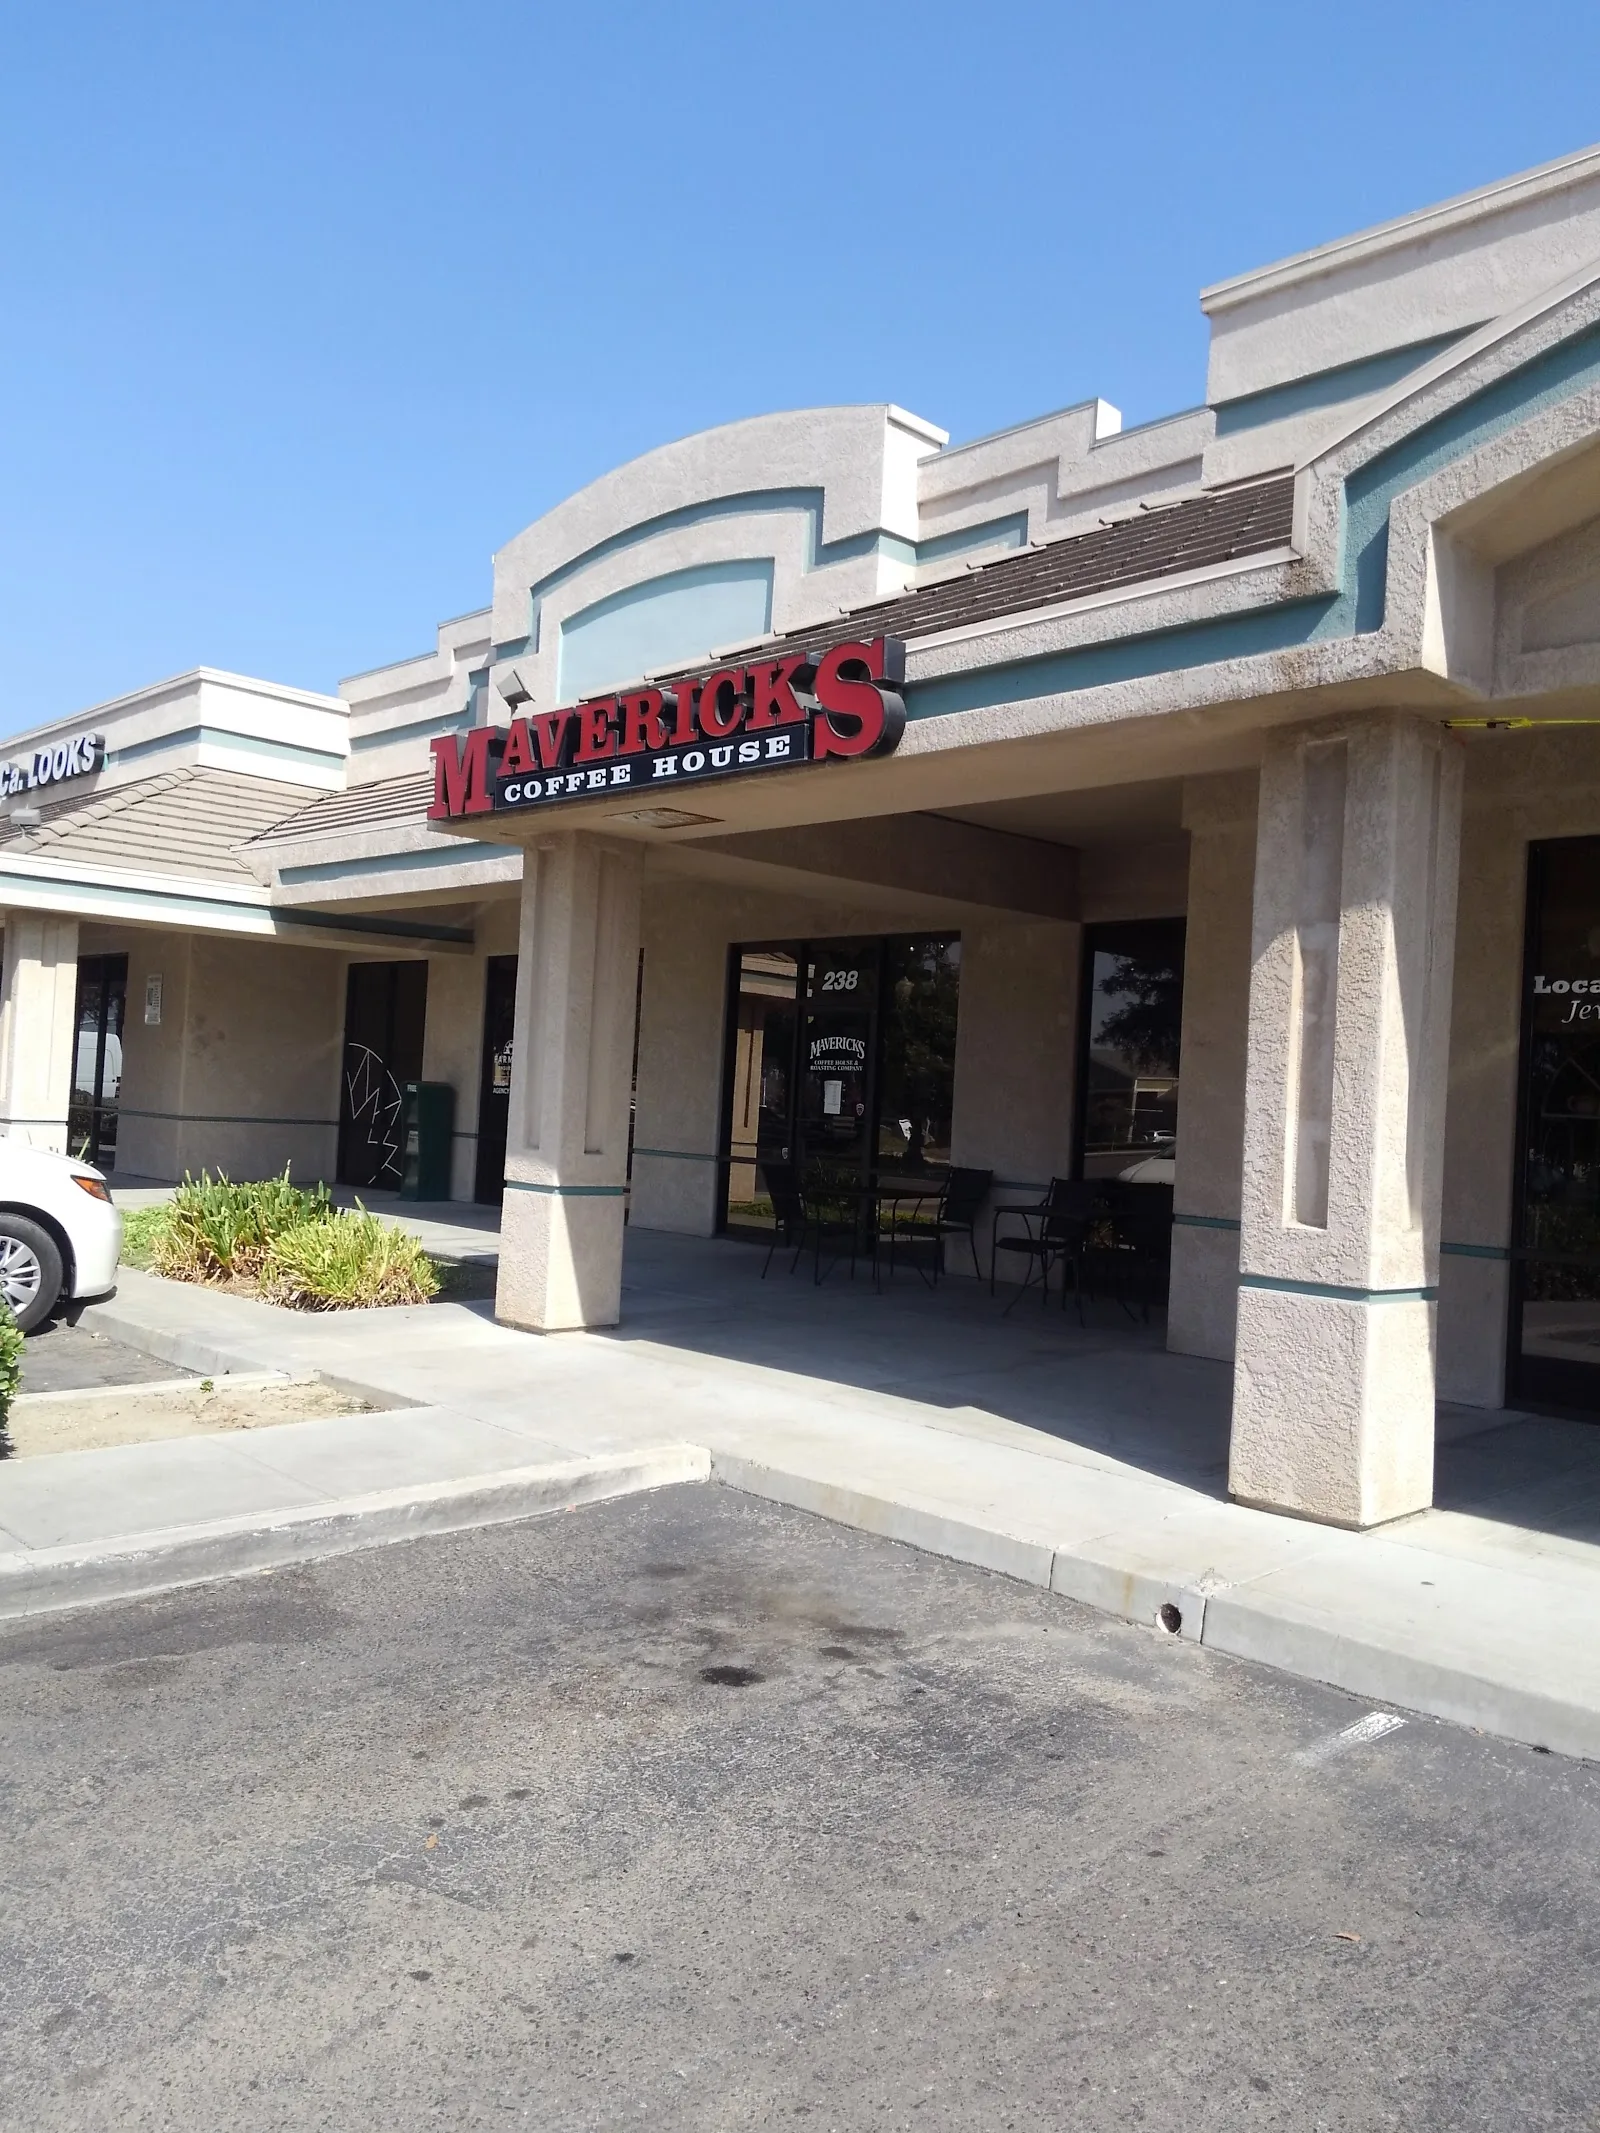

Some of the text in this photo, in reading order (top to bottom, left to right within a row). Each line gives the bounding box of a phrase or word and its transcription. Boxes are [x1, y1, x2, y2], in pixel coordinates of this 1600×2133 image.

[427, 637, 886, 820] MAVERICKS
[27, 733, 97, 788] LOOKS
[504, 735, 791, 802] COFFEE HOUSE
[822, 970, 859, 991] 238
[809, 1036, 865, 1060] MAVERICKS
